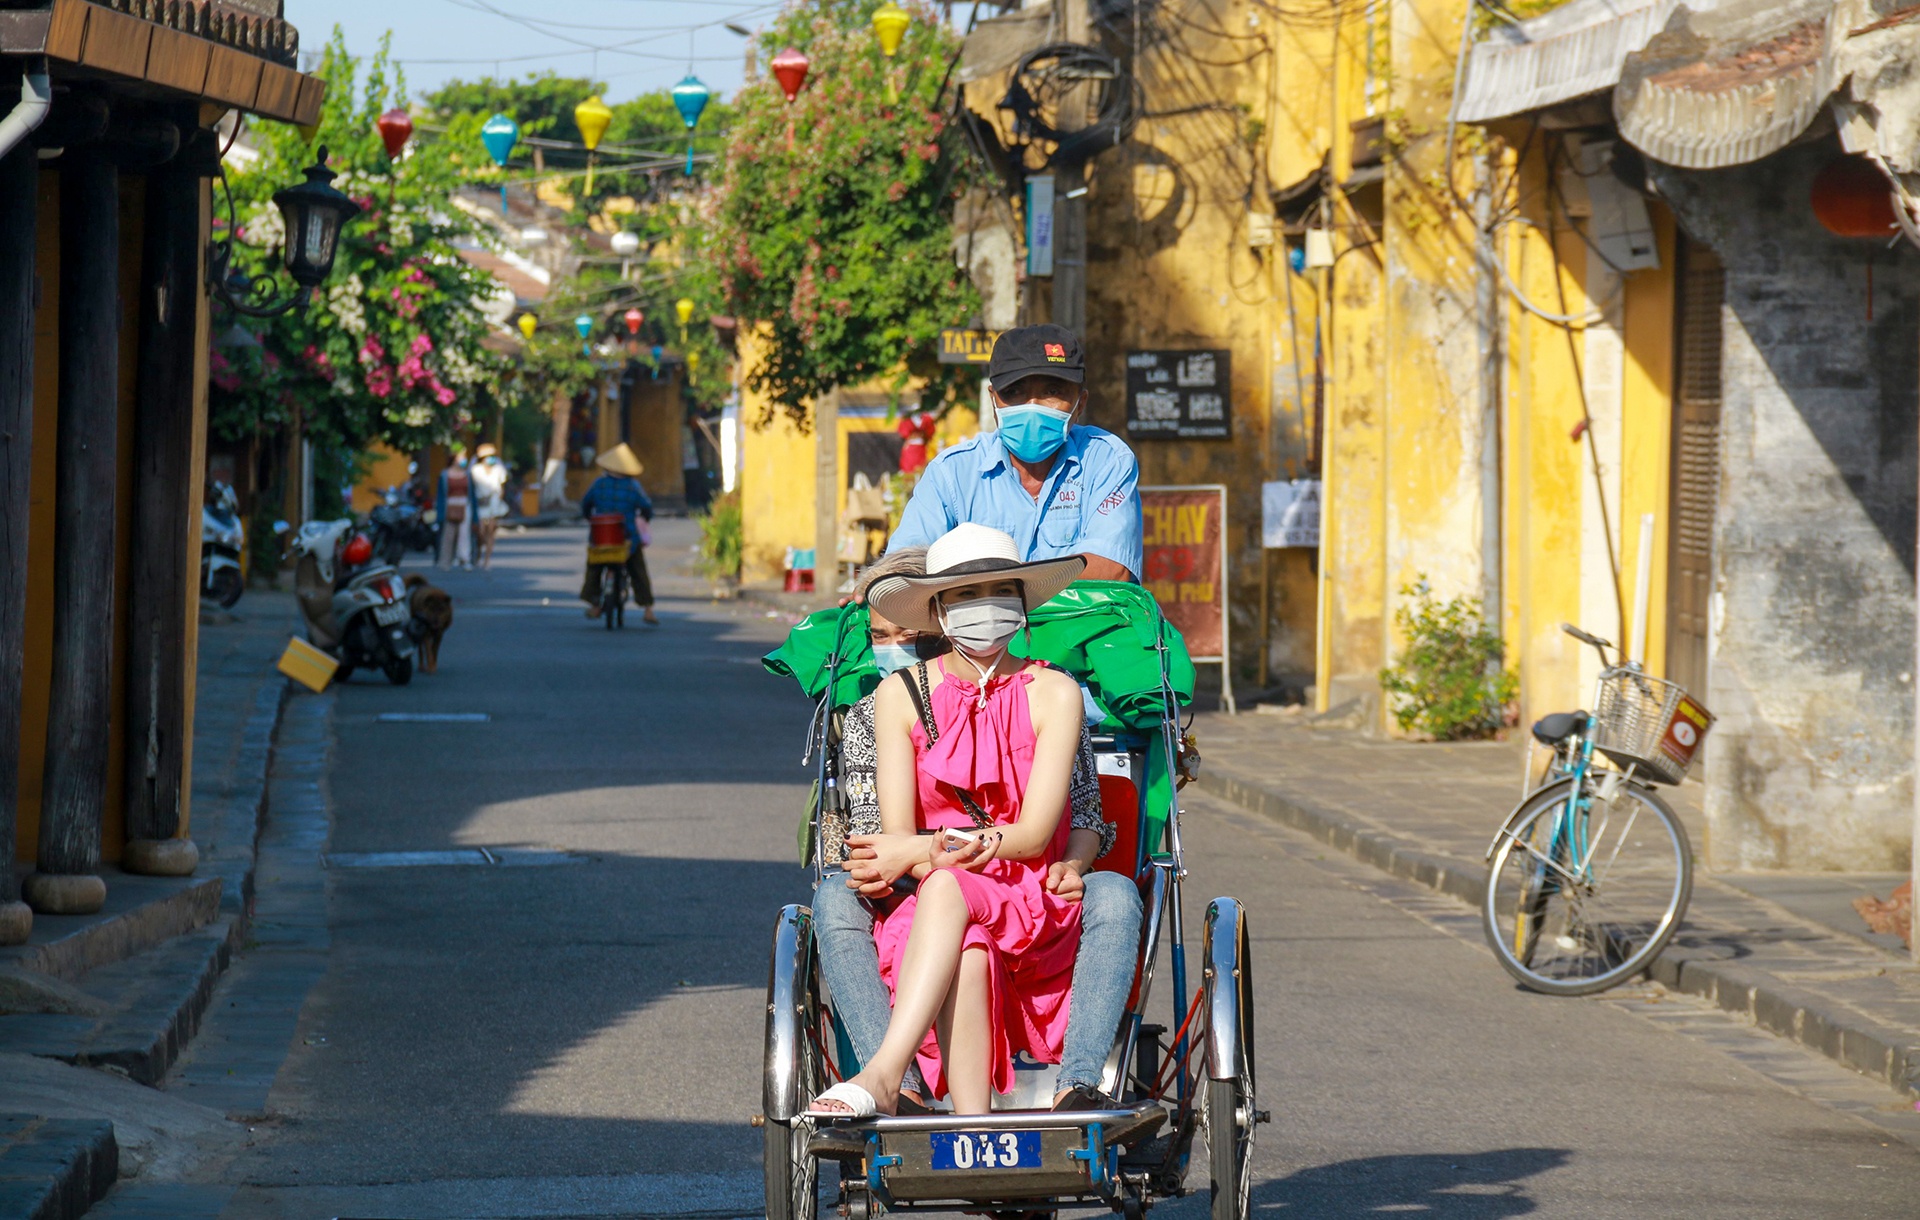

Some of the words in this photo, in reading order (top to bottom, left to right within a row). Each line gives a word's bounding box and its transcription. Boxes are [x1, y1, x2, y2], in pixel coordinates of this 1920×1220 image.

[942, 329, 1003, 354] TATTO
[1059, 490, 1076, 502] 043
[1142, 504, 1208, 544] CHAY
[1147, 547, 1194, 580] 69
[953, 1133, 1019, 1169] 043
